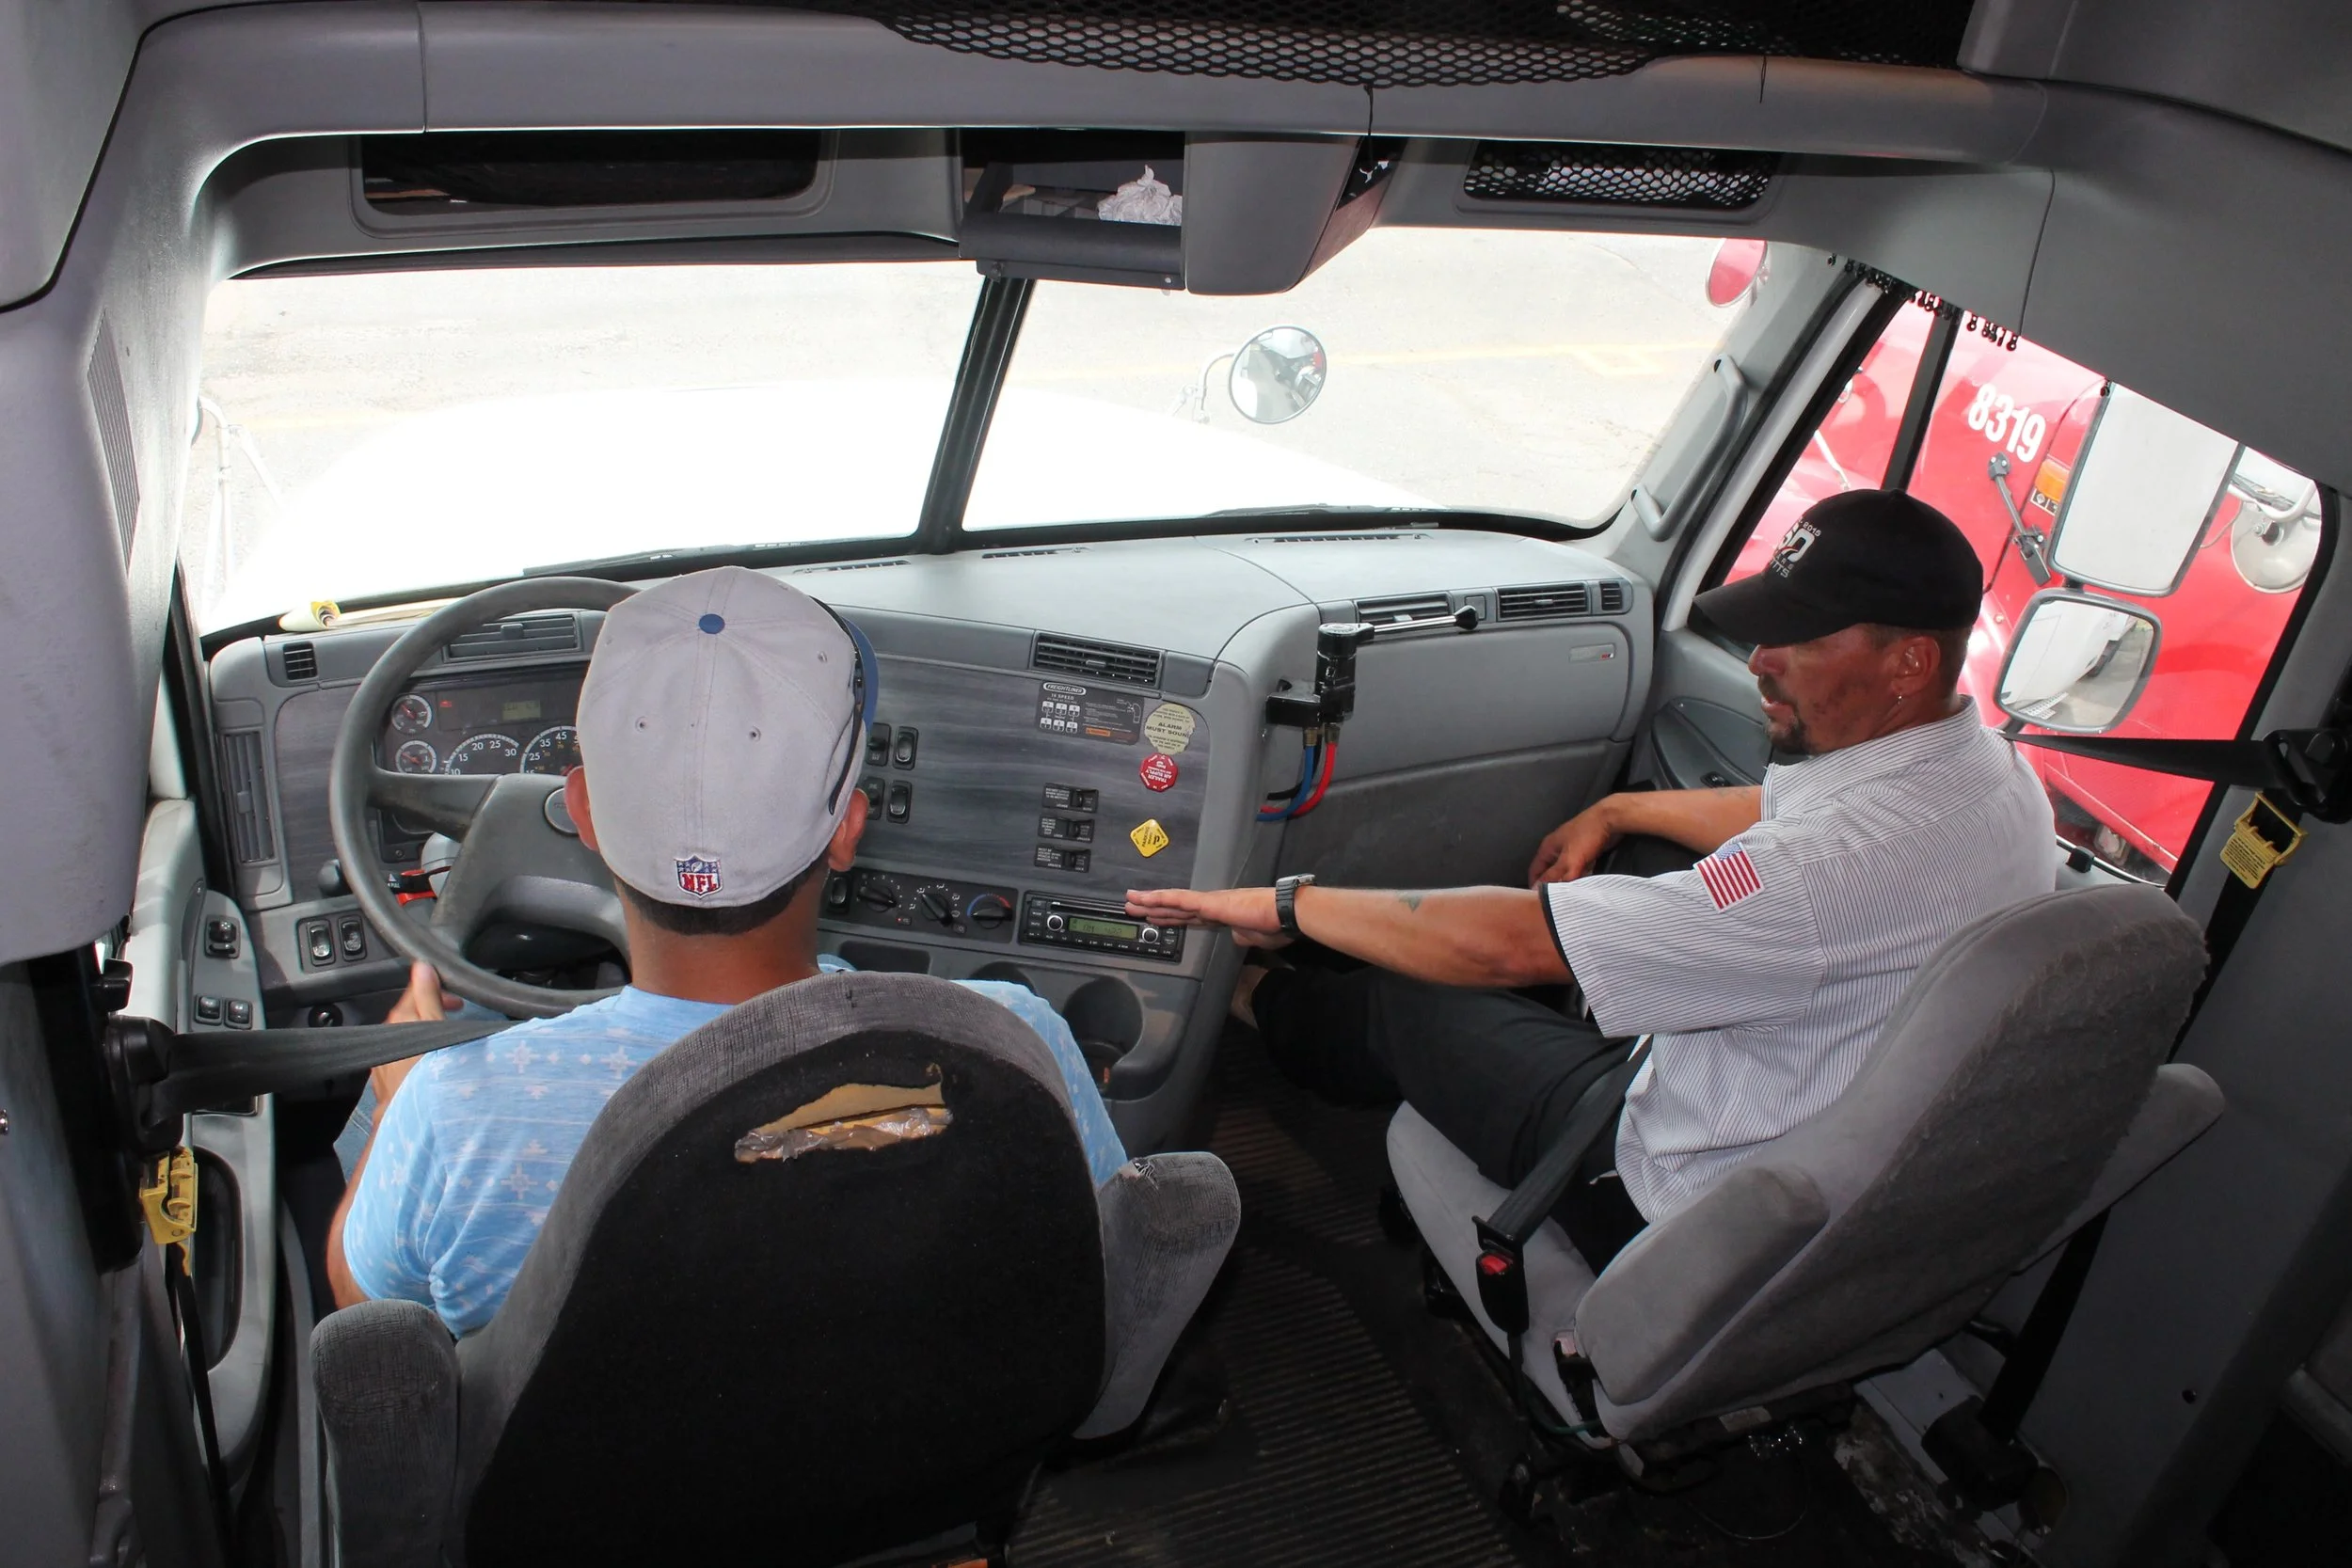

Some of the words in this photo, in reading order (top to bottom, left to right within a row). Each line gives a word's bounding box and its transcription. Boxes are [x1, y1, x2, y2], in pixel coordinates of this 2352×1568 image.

[1967, 383, 2046, 463] 8319
[1803, 521, 1822, 537] 2015
[1047, 684, 1083, 694] FREIGHTLINER
[1146, 725, 1166, 734] MUST
[1168, 730, 1188, 738] SOUN
[1158, 722, 1183, 731] ALARM
[555, 731, 567, 740] 45
[471, 742, 485, 751] 20
[489, 740, 501, 749] 25
[539, 738, 551, 748] 35
[458, 753, 469, 762] 15
[529, 752, 541, 761] 25
[504, 748, 517, 757] 30
[1148, 773, 1167, 783] TRAILER
[681, 873, 718, 893] NFL
